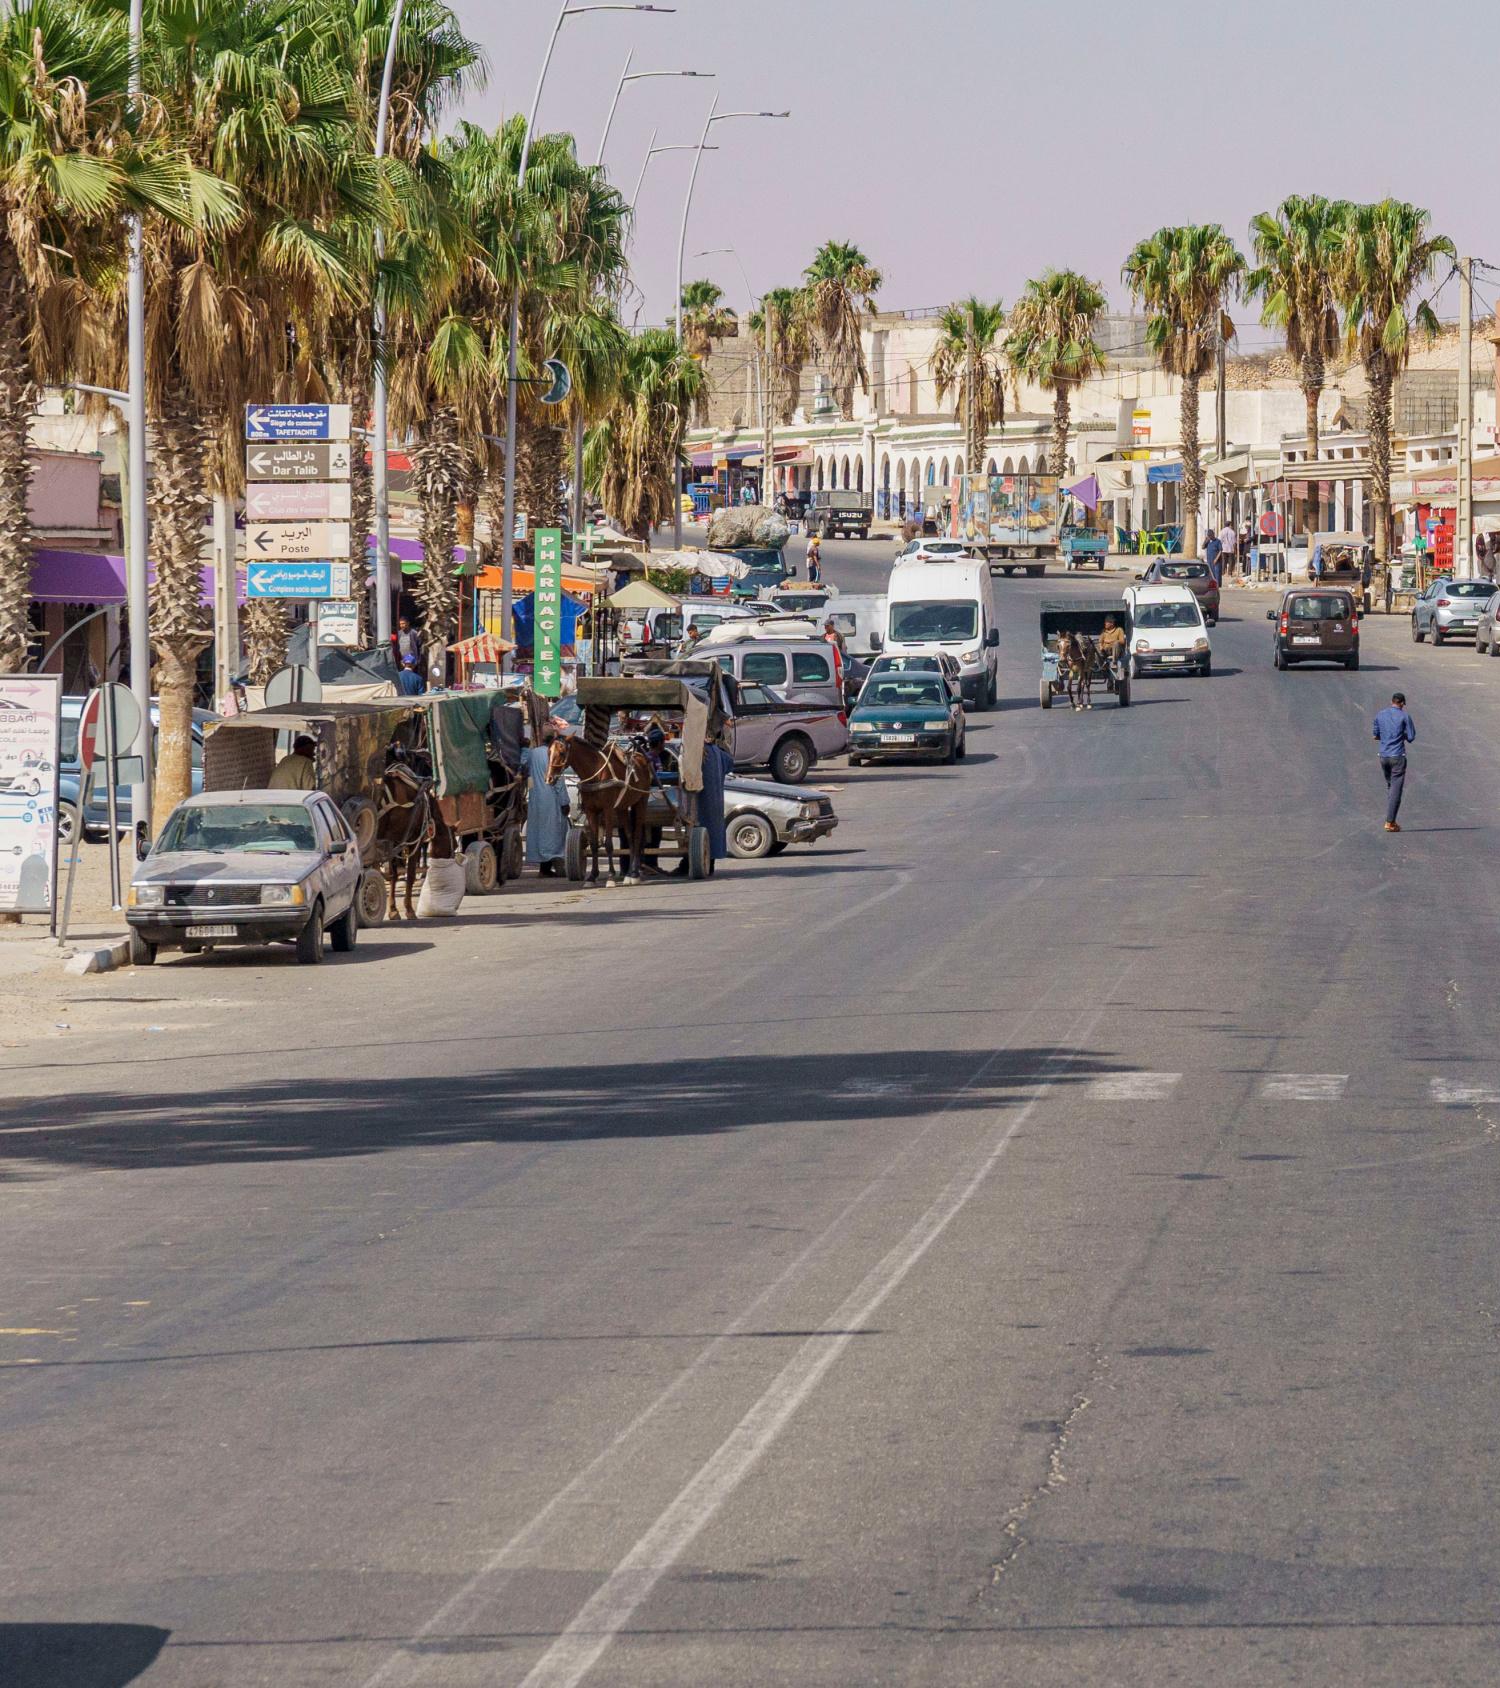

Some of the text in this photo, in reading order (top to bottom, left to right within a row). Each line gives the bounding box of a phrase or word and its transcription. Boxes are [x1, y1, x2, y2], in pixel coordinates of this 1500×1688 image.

[274, 451, 315, 463] دار الطالب
[273, 466, 318, 475] Dar Talib
[281, 527, 312, 540] البريد
[281, 545, 310, 553] Poste
[538, 536, 555, 660] PHARMACIE
